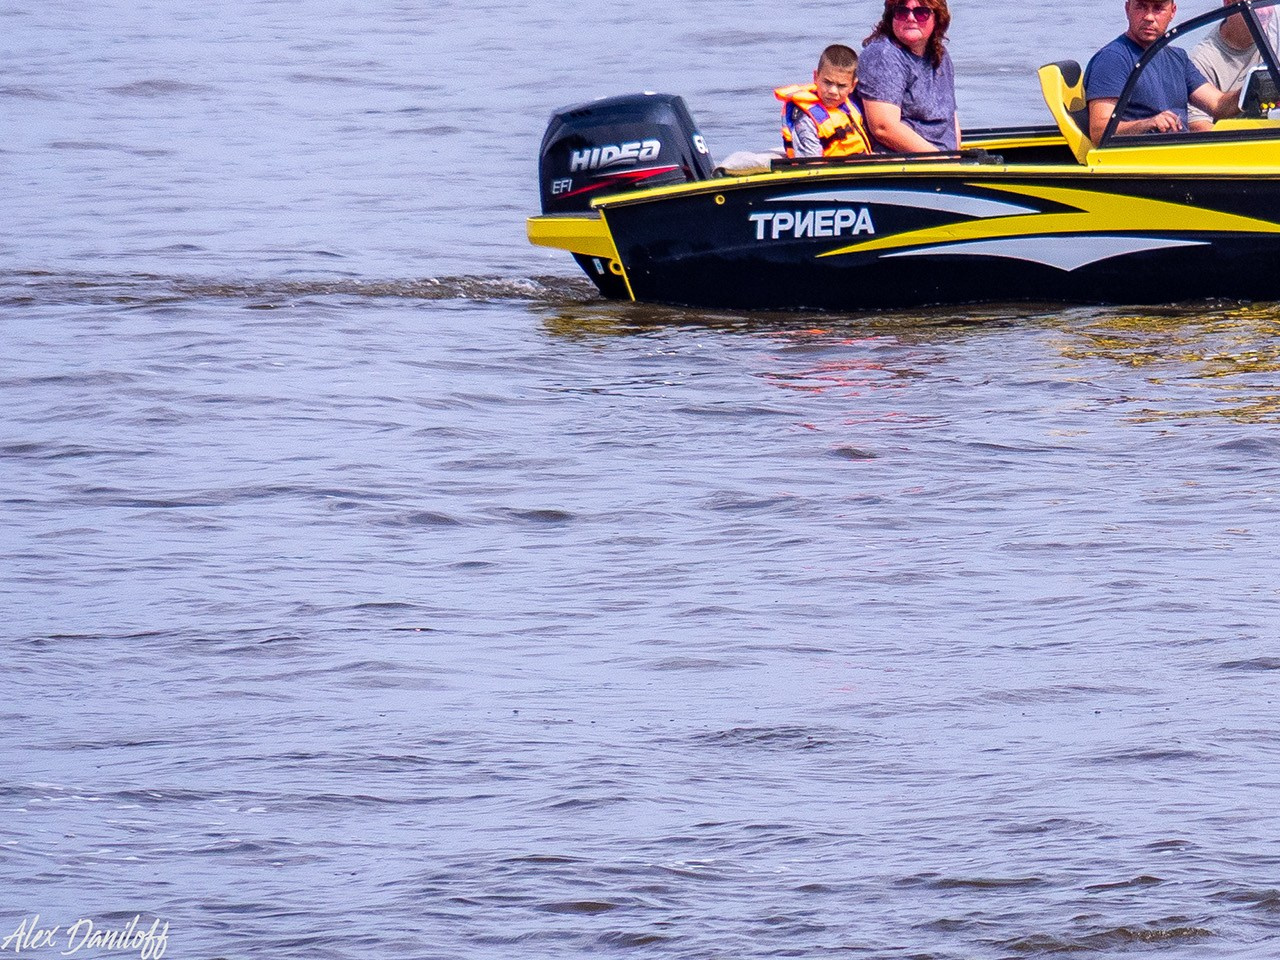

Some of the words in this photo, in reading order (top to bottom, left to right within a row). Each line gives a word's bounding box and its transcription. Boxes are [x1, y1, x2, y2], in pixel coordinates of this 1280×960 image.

[570, 139, 661, 172] HIDEA
[552, 179, 572, 195] EFI
[749, 208, 875, 240] ТРИЕРА
